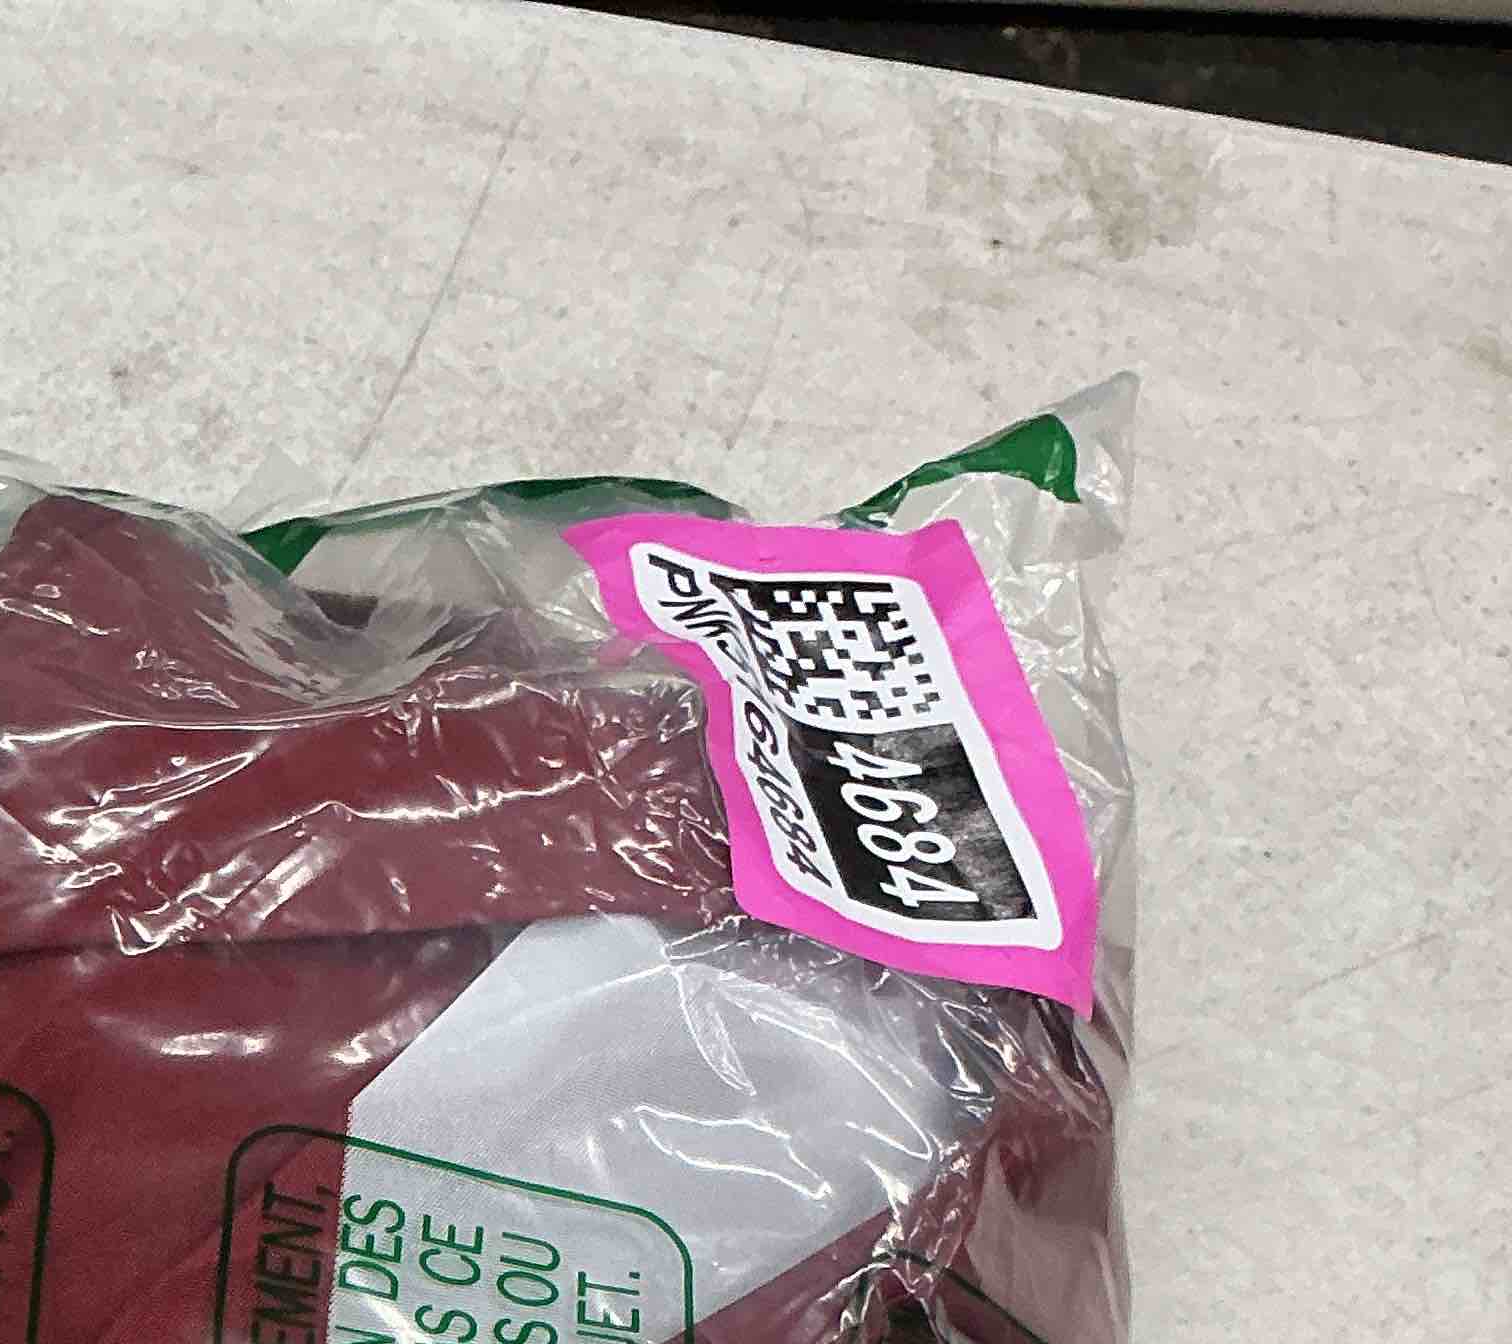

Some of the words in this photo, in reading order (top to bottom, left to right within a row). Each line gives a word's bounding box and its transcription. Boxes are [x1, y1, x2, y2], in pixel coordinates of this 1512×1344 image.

[824, 740, 981, 907] 4684
[340, 1193, 406, 1300] DES
[413, 1217, 485, 1287] CE
[497, 1232, 561, 1308] OU
